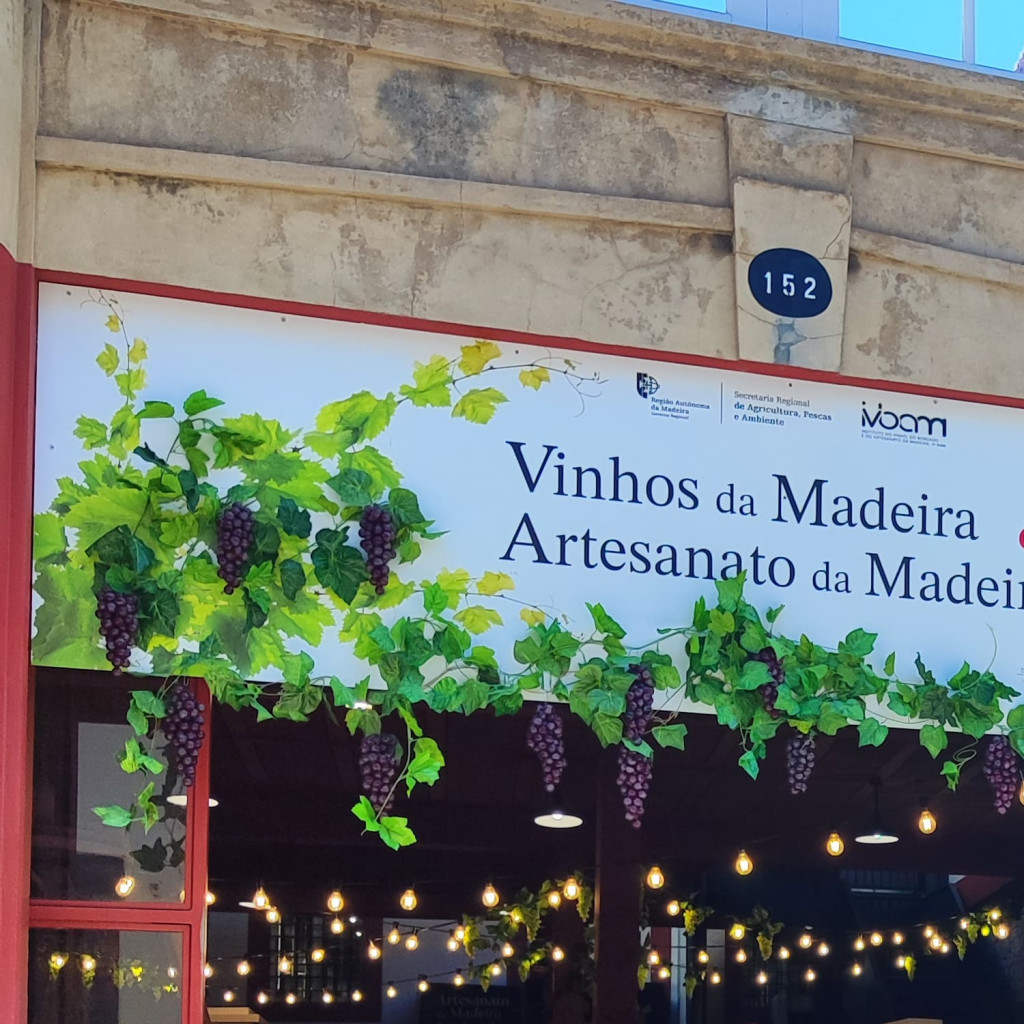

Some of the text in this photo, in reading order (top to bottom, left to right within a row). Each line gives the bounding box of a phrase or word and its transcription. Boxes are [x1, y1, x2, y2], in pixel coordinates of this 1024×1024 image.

[764, 271, 816, 300] 152
[734, 391, 810, 408] Secretaria Regional
[661, 406, 689, 414] Madeira
[734, 402, 832, 421] de Agricultura, Pescas
[742, 414, 785, 426] Ambiente
[505, 440, 700, 510] Vinhos
[716, 484, 757, 517] da
[771, 474, 979, 541] Madeira
[498, 512, 796, 589] Artesanato
[811, 562, 852, 594] da
